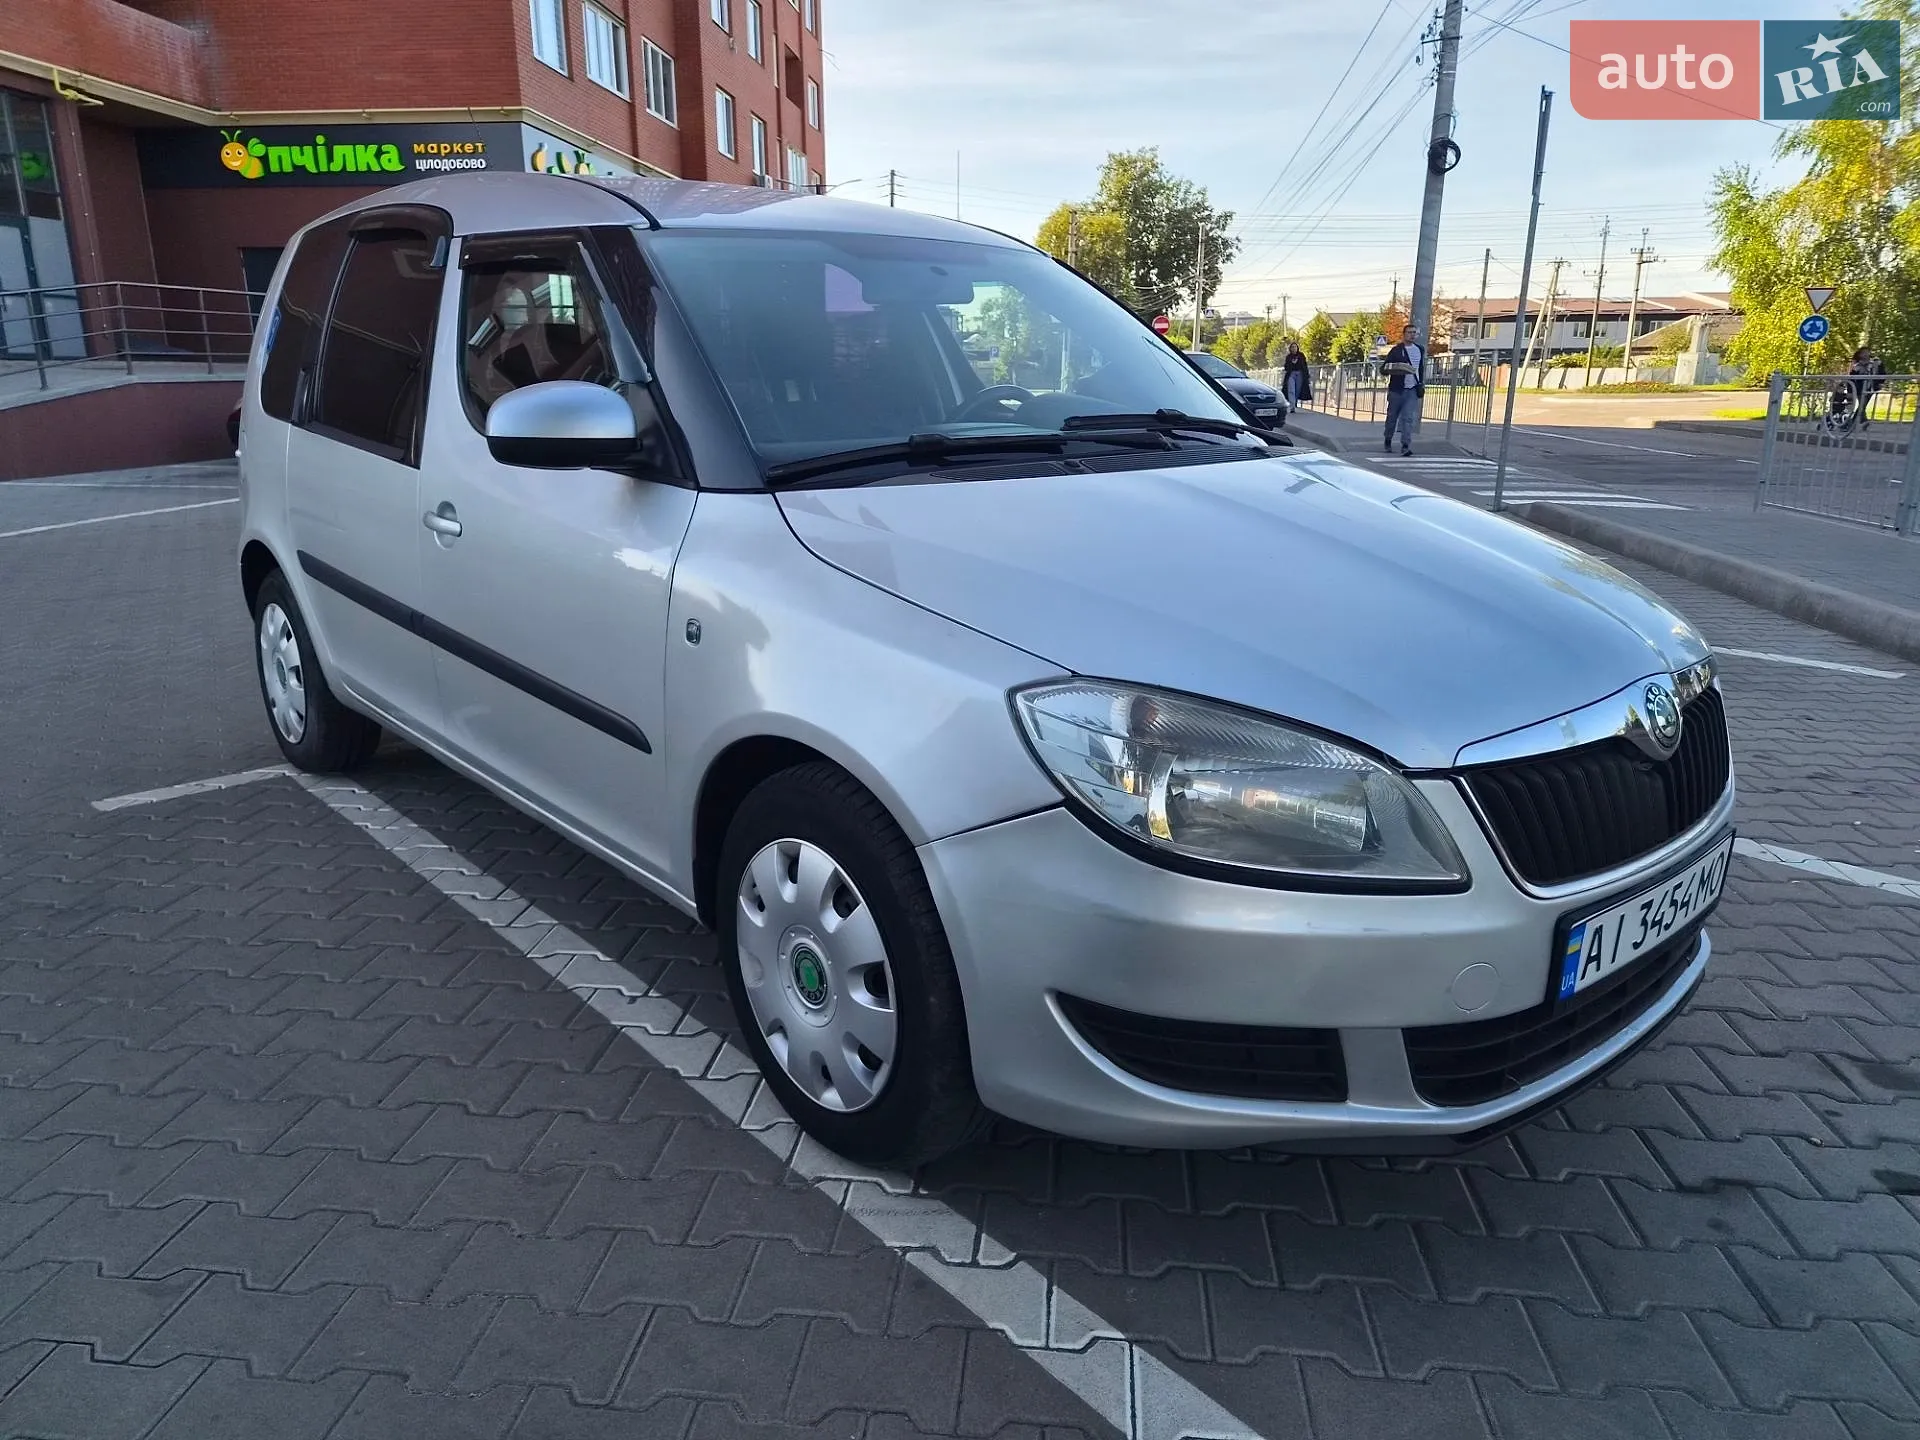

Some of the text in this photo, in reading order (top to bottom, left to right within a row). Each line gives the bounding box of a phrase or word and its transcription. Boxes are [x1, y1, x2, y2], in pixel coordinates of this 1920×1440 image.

[267, 134, 405, 173] пчілка
[413, 142, 486, 156] маркет
[415, 158, 487, 171] ЦІЛОДОБОВО
[1561, 971, 1575, 991] UA
